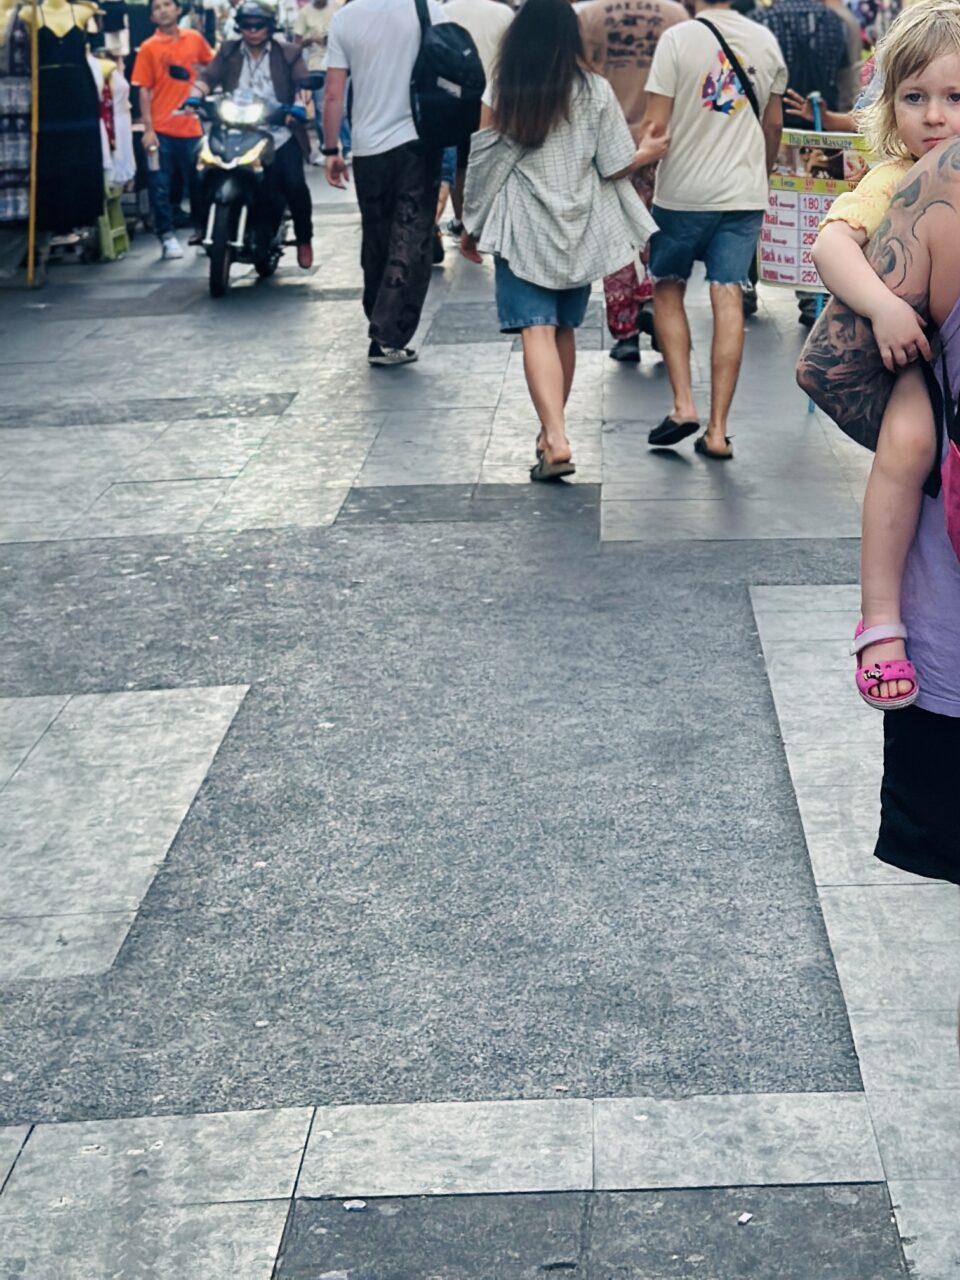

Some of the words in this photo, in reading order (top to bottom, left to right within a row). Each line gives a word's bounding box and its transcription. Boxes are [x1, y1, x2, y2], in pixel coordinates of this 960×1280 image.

[803, 197, 819, 210] 180
[764, 211, 779, 226] hai
[803, 217, 818, 229] 180
[801, 269, 818, 283] 250
